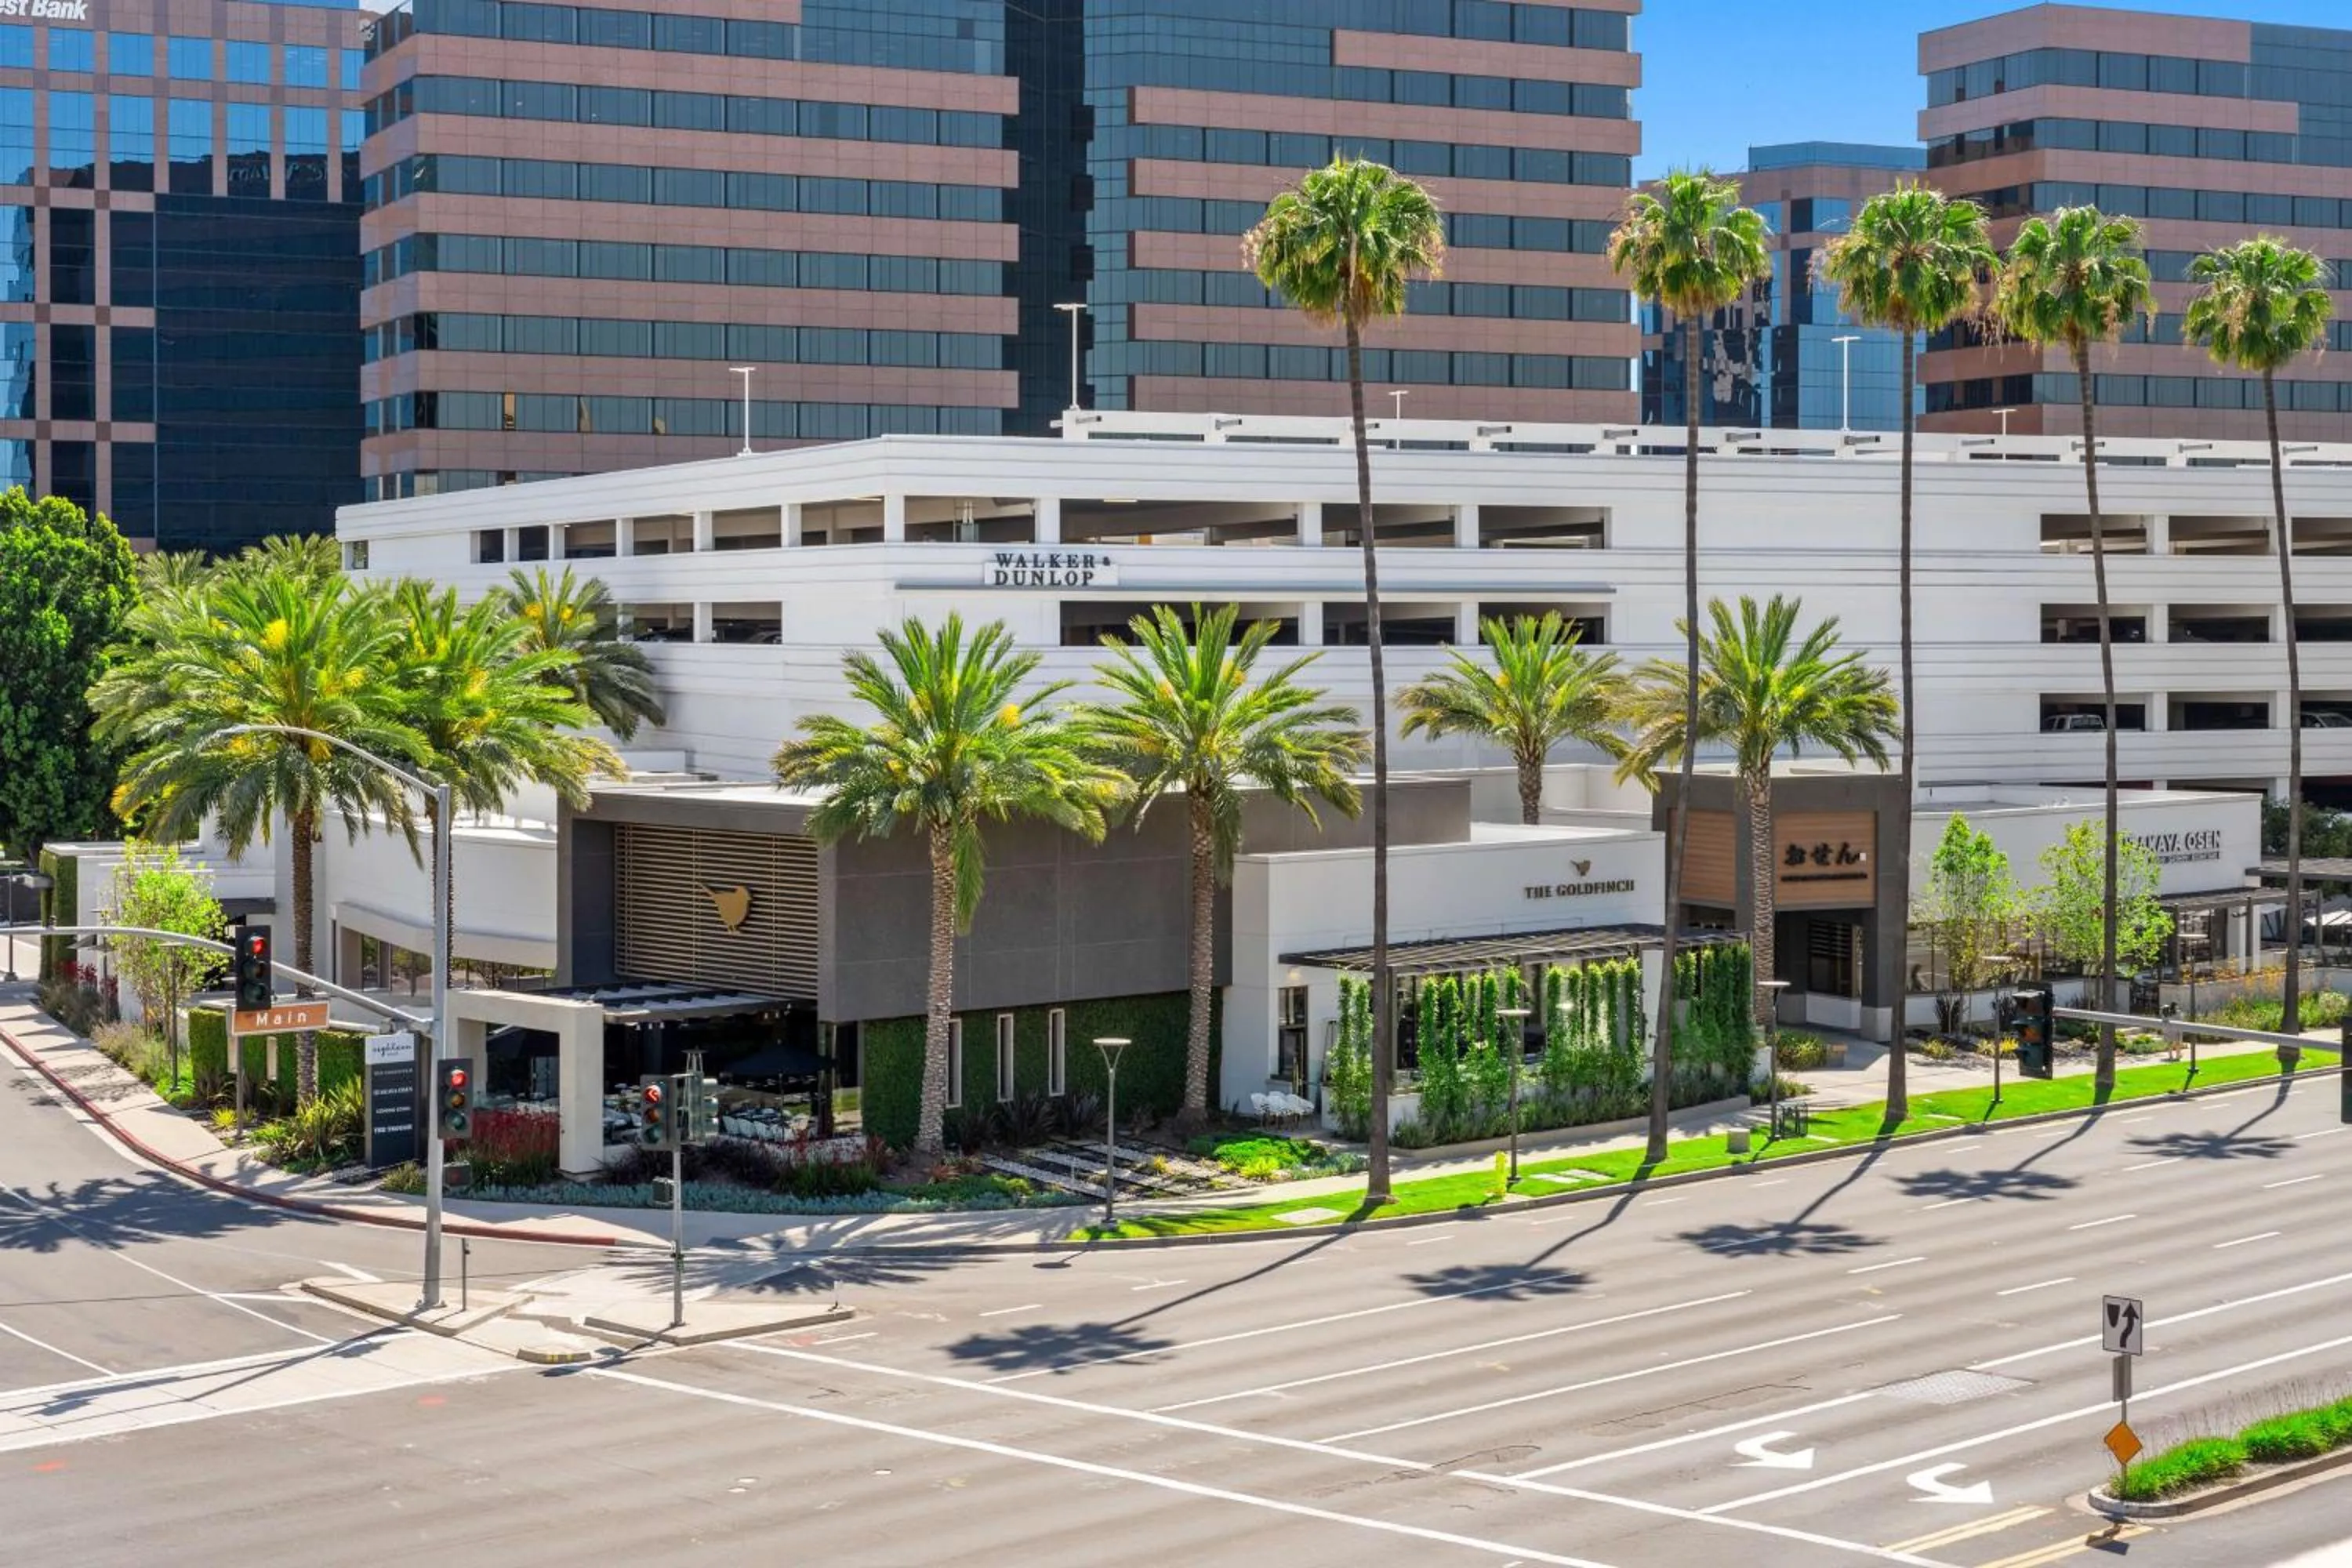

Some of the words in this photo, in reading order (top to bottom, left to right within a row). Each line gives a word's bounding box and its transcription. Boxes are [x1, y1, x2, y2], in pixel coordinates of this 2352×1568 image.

[31, 0, 88, 20] Bank
[995, 554, 1095, 568] WALKER
[995, 570, 1094, 586] DUNLOP
[2185, 829, 2222, 850] OSEN
[1525, 887, 1552, 899] THE
[1557, 880, 1635, 897] GOLDFINCH
[256, 1011, 307, 1026] Main
